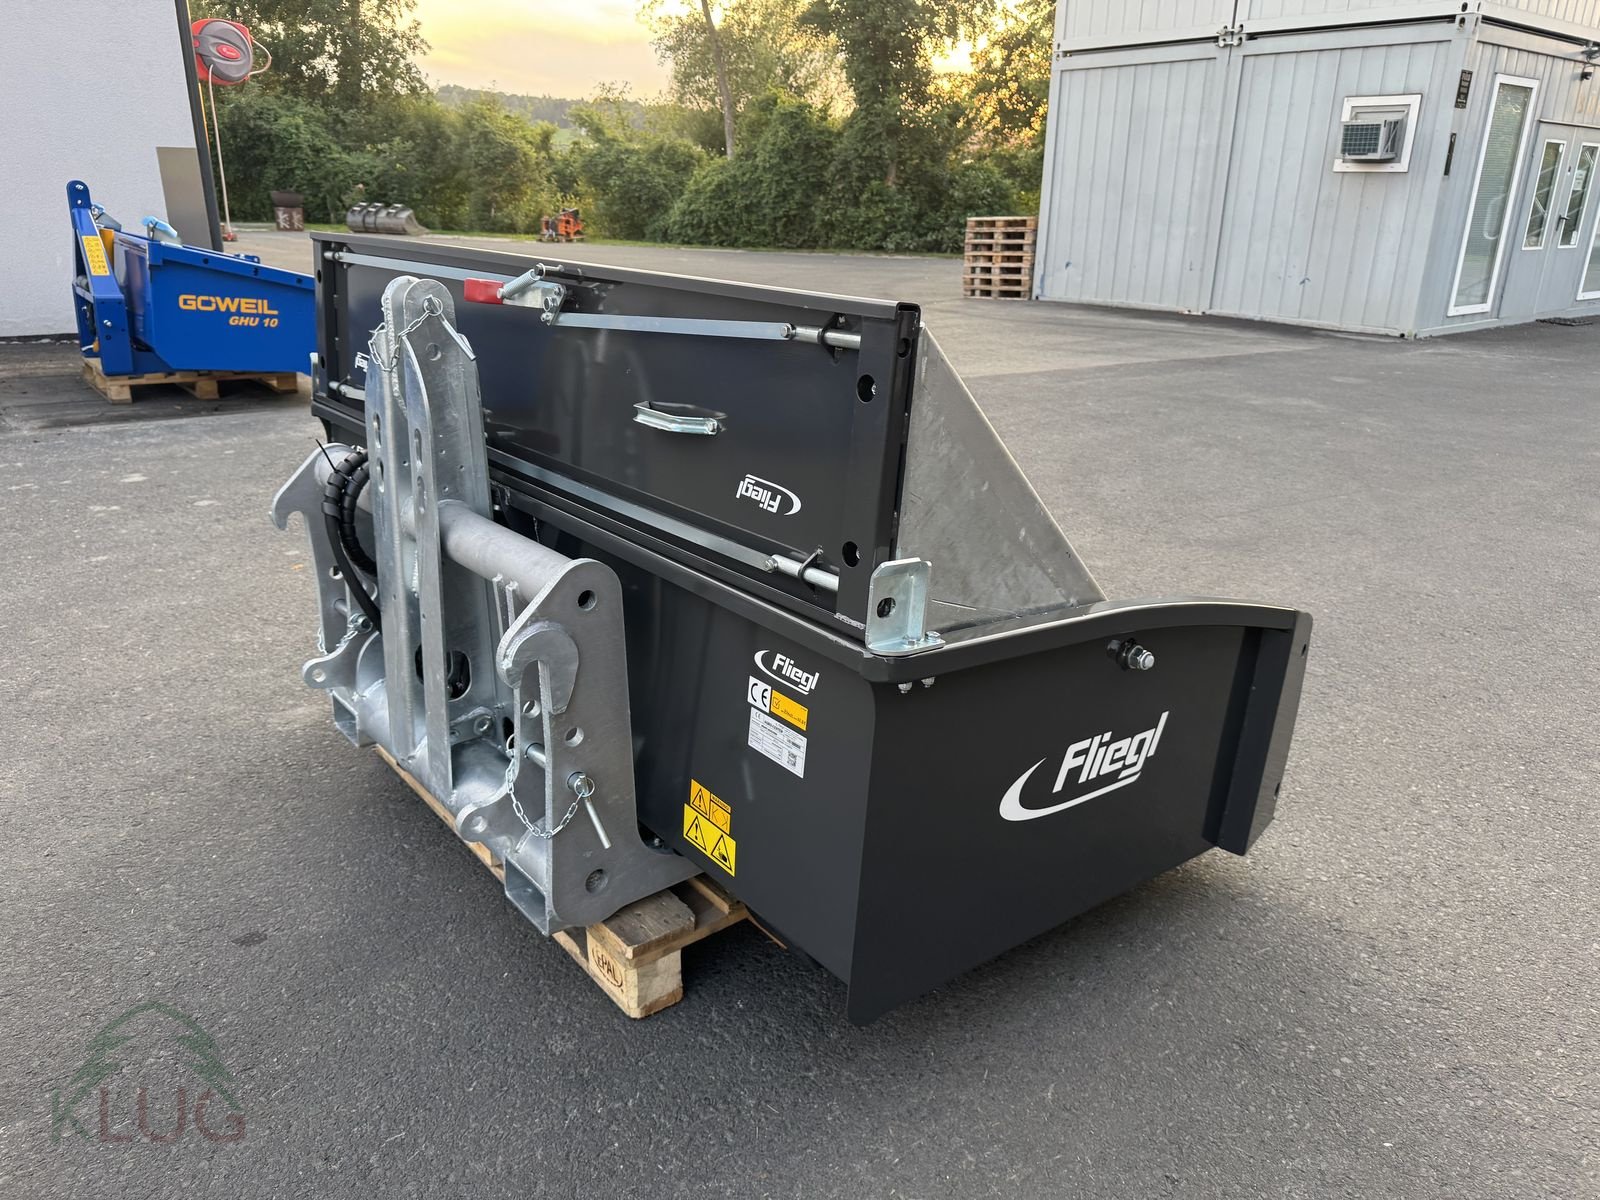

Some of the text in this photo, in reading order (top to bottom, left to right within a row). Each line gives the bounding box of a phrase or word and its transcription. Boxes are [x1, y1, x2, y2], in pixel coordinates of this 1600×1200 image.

[229, 316, 278, 328] GHU 10
[735, 477, 782, 513] Fliegl
[772, 653, 820, 692] Fliegl
[750, 682, 769, 708] CE
[1052, 710, 1170, 794] Fliegl
